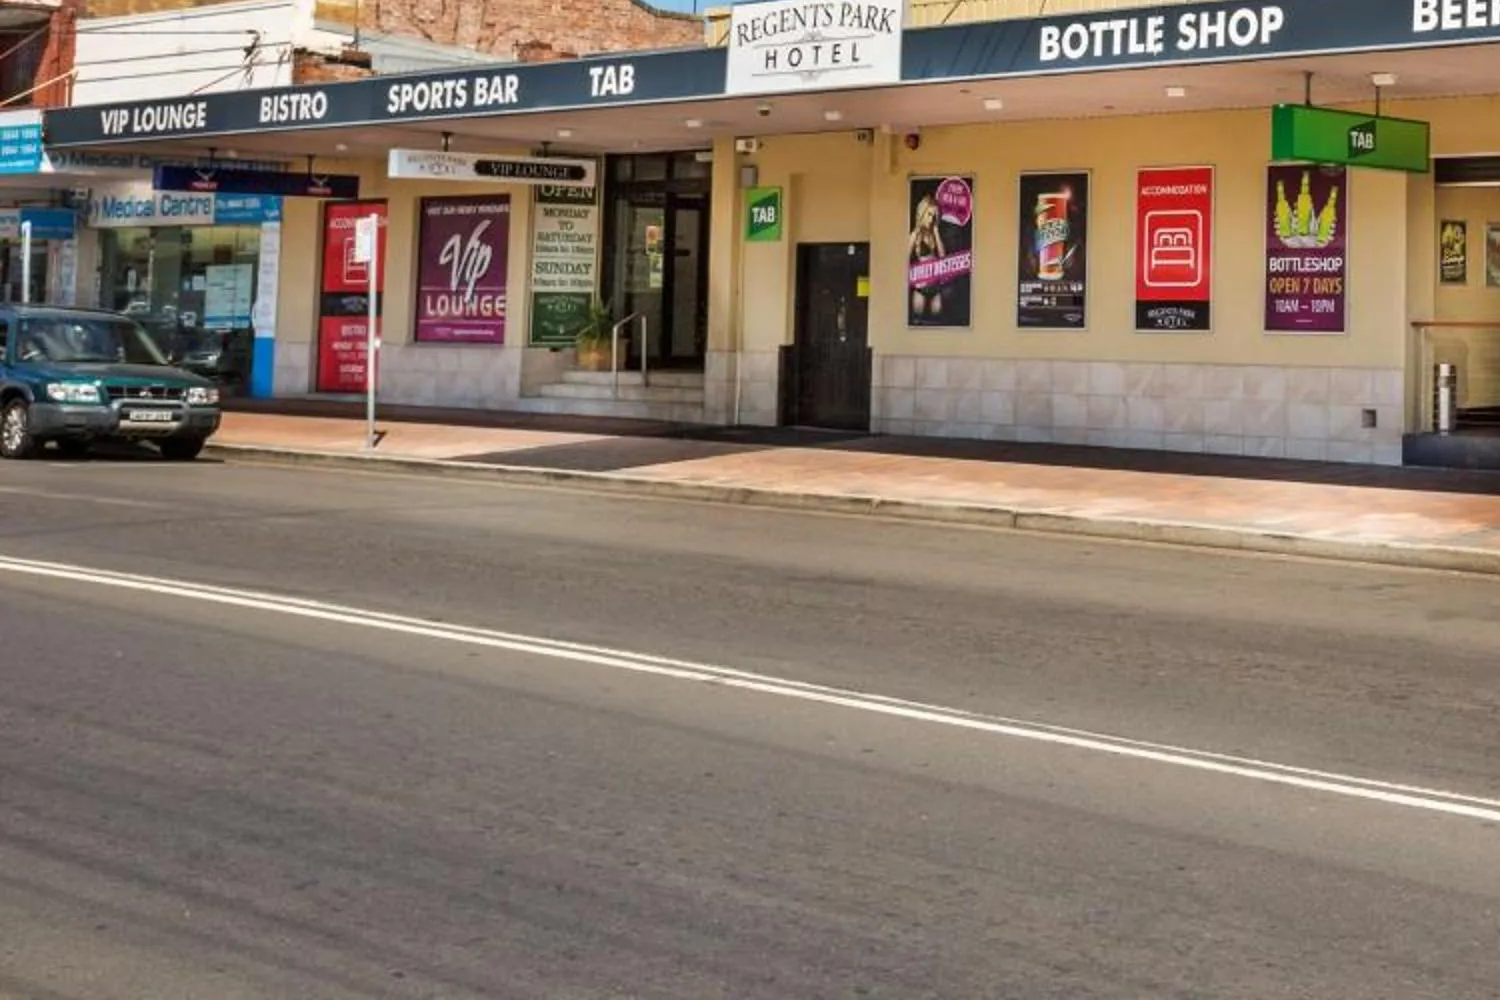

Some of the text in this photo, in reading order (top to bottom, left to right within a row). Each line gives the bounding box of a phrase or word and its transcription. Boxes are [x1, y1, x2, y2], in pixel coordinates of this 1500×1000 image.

[737, 1, 897, 47] REGENTS PARK
[1039, 5, 1285, 62] BOTTLE SHOP
[764, 41, 861, 70] HOTEL
[387, 74, 519, 113] SPORTS BAR
[589, 64, 635, 97] TAB
[101, 101, 208, 135] VIP LOUNGE
[259, 91, 328, 123] BISTRO
[1350, 131, 1374, 149] TAB
[752, 205, 776, 224] TAB
[535, 261, 592, 276] SUNDAY
[1269, 256, 1344, 273] BOTTLESHOP
[1269, 276, 1343, 295] OPEN 7 DAYS
[426, 294, 506, 318] LOUNGE
